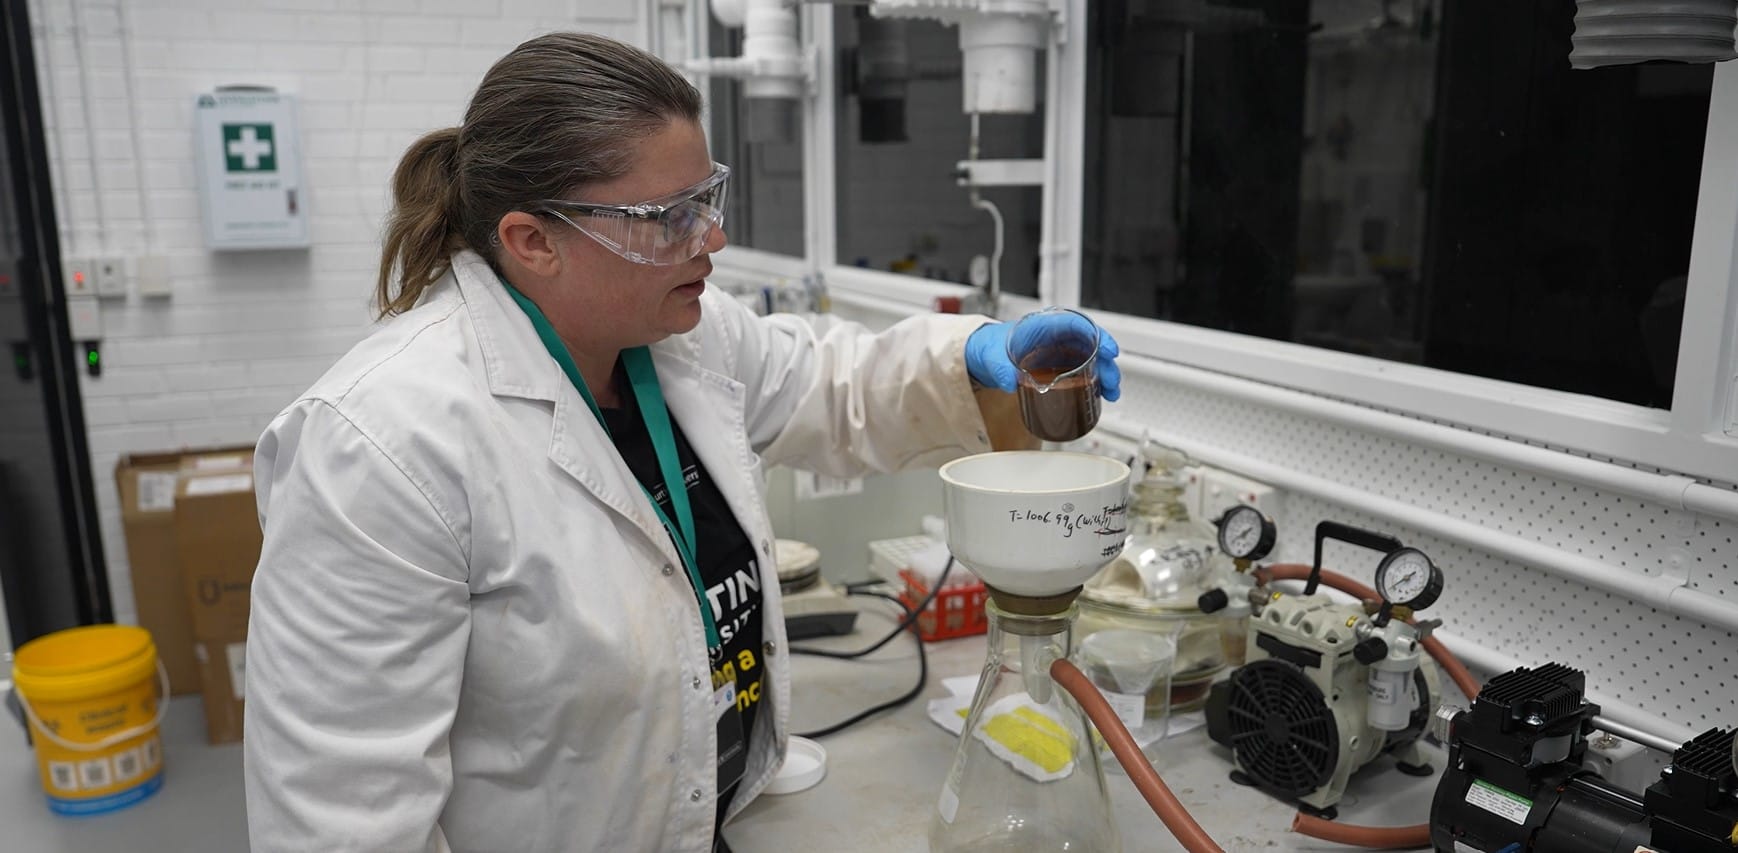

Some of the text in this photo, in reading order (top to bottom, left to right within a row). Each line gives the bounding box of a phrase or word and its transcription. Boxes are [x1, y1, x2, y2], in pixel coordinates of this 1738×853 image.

[705, 559, 761, 622] TIN
[720, 604, 756, 645] SIT
[711, 649, 756, 692] ng a
[736, 681, 761, 712] nc
